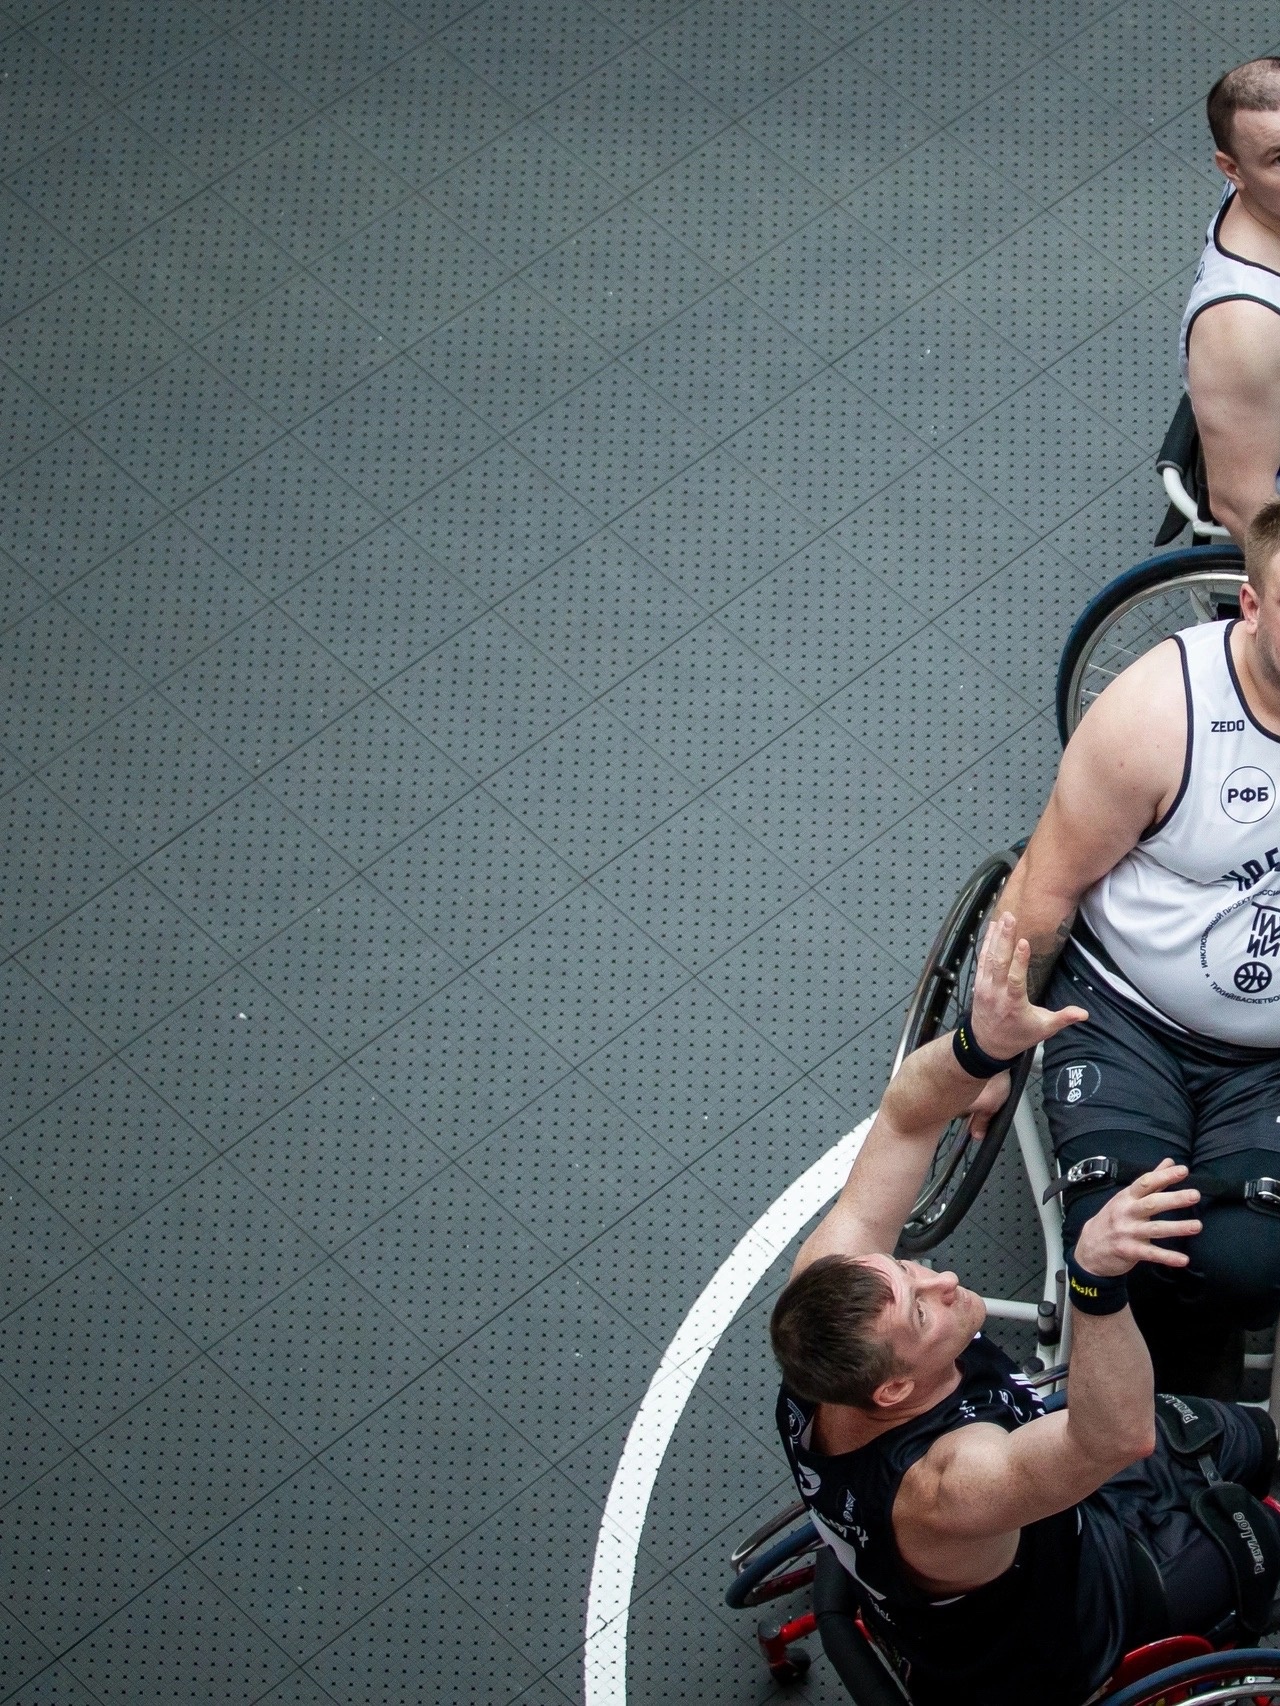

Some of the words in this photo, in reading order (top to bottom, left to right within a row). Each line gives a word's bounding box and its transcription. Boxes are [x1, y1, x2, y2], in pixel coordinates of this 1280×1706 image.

[1211, 719, 1245, 733] ZEDO
[1227, 786, 1269, 804] РФБ
[1222, 896, 1252, 916] ПРОЕКТ
